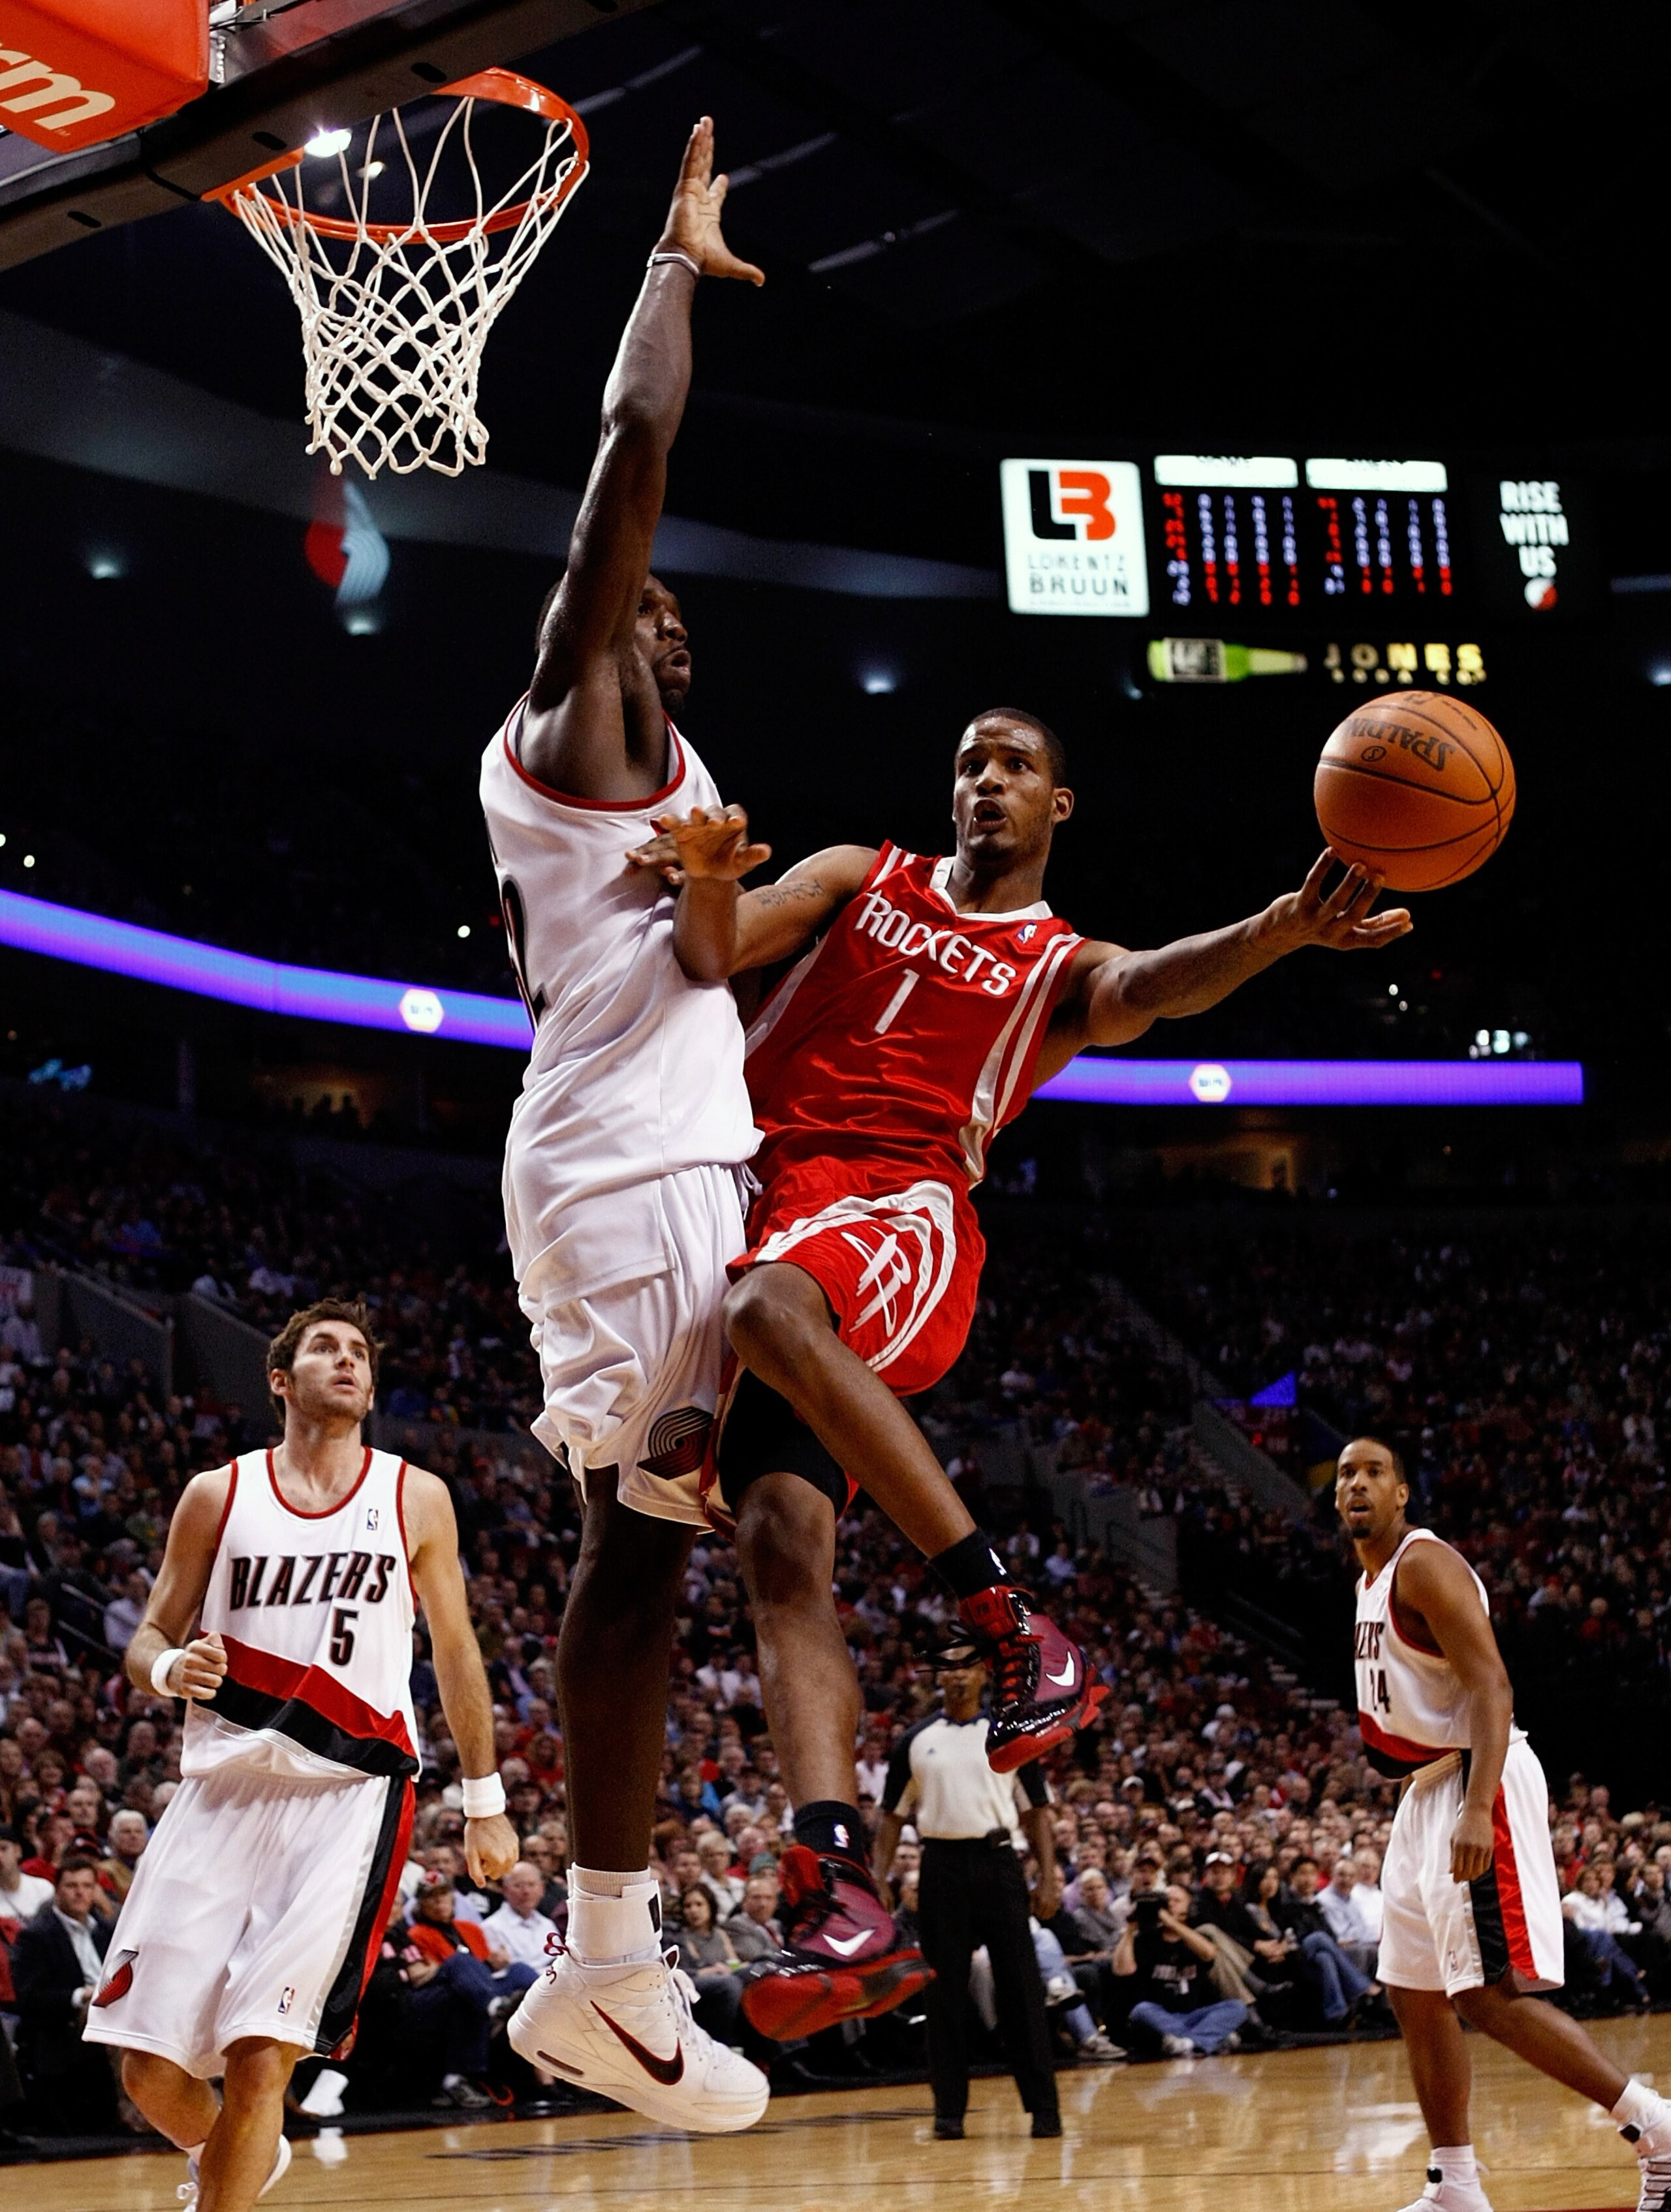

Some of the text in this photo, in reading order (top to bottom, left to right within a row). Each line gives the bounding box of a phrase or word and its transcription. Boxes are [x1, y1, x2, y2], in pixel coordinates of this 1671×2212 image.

[1499, 480, 1563, 512] RISE
[1499, 512, 1570, 546] WITH
[1518, 545, 1557, 578] US
[1029, 573, 1129, 596] BRUUN
[1323, 642, 1484, 672] JONES
[853, 889, 1017, 997] ROCKETS
[873, 967, 920, 1035] 1
[230, 1551, 396, 1610] BLAZERS
[330, 1608, 358, 1666] 5
